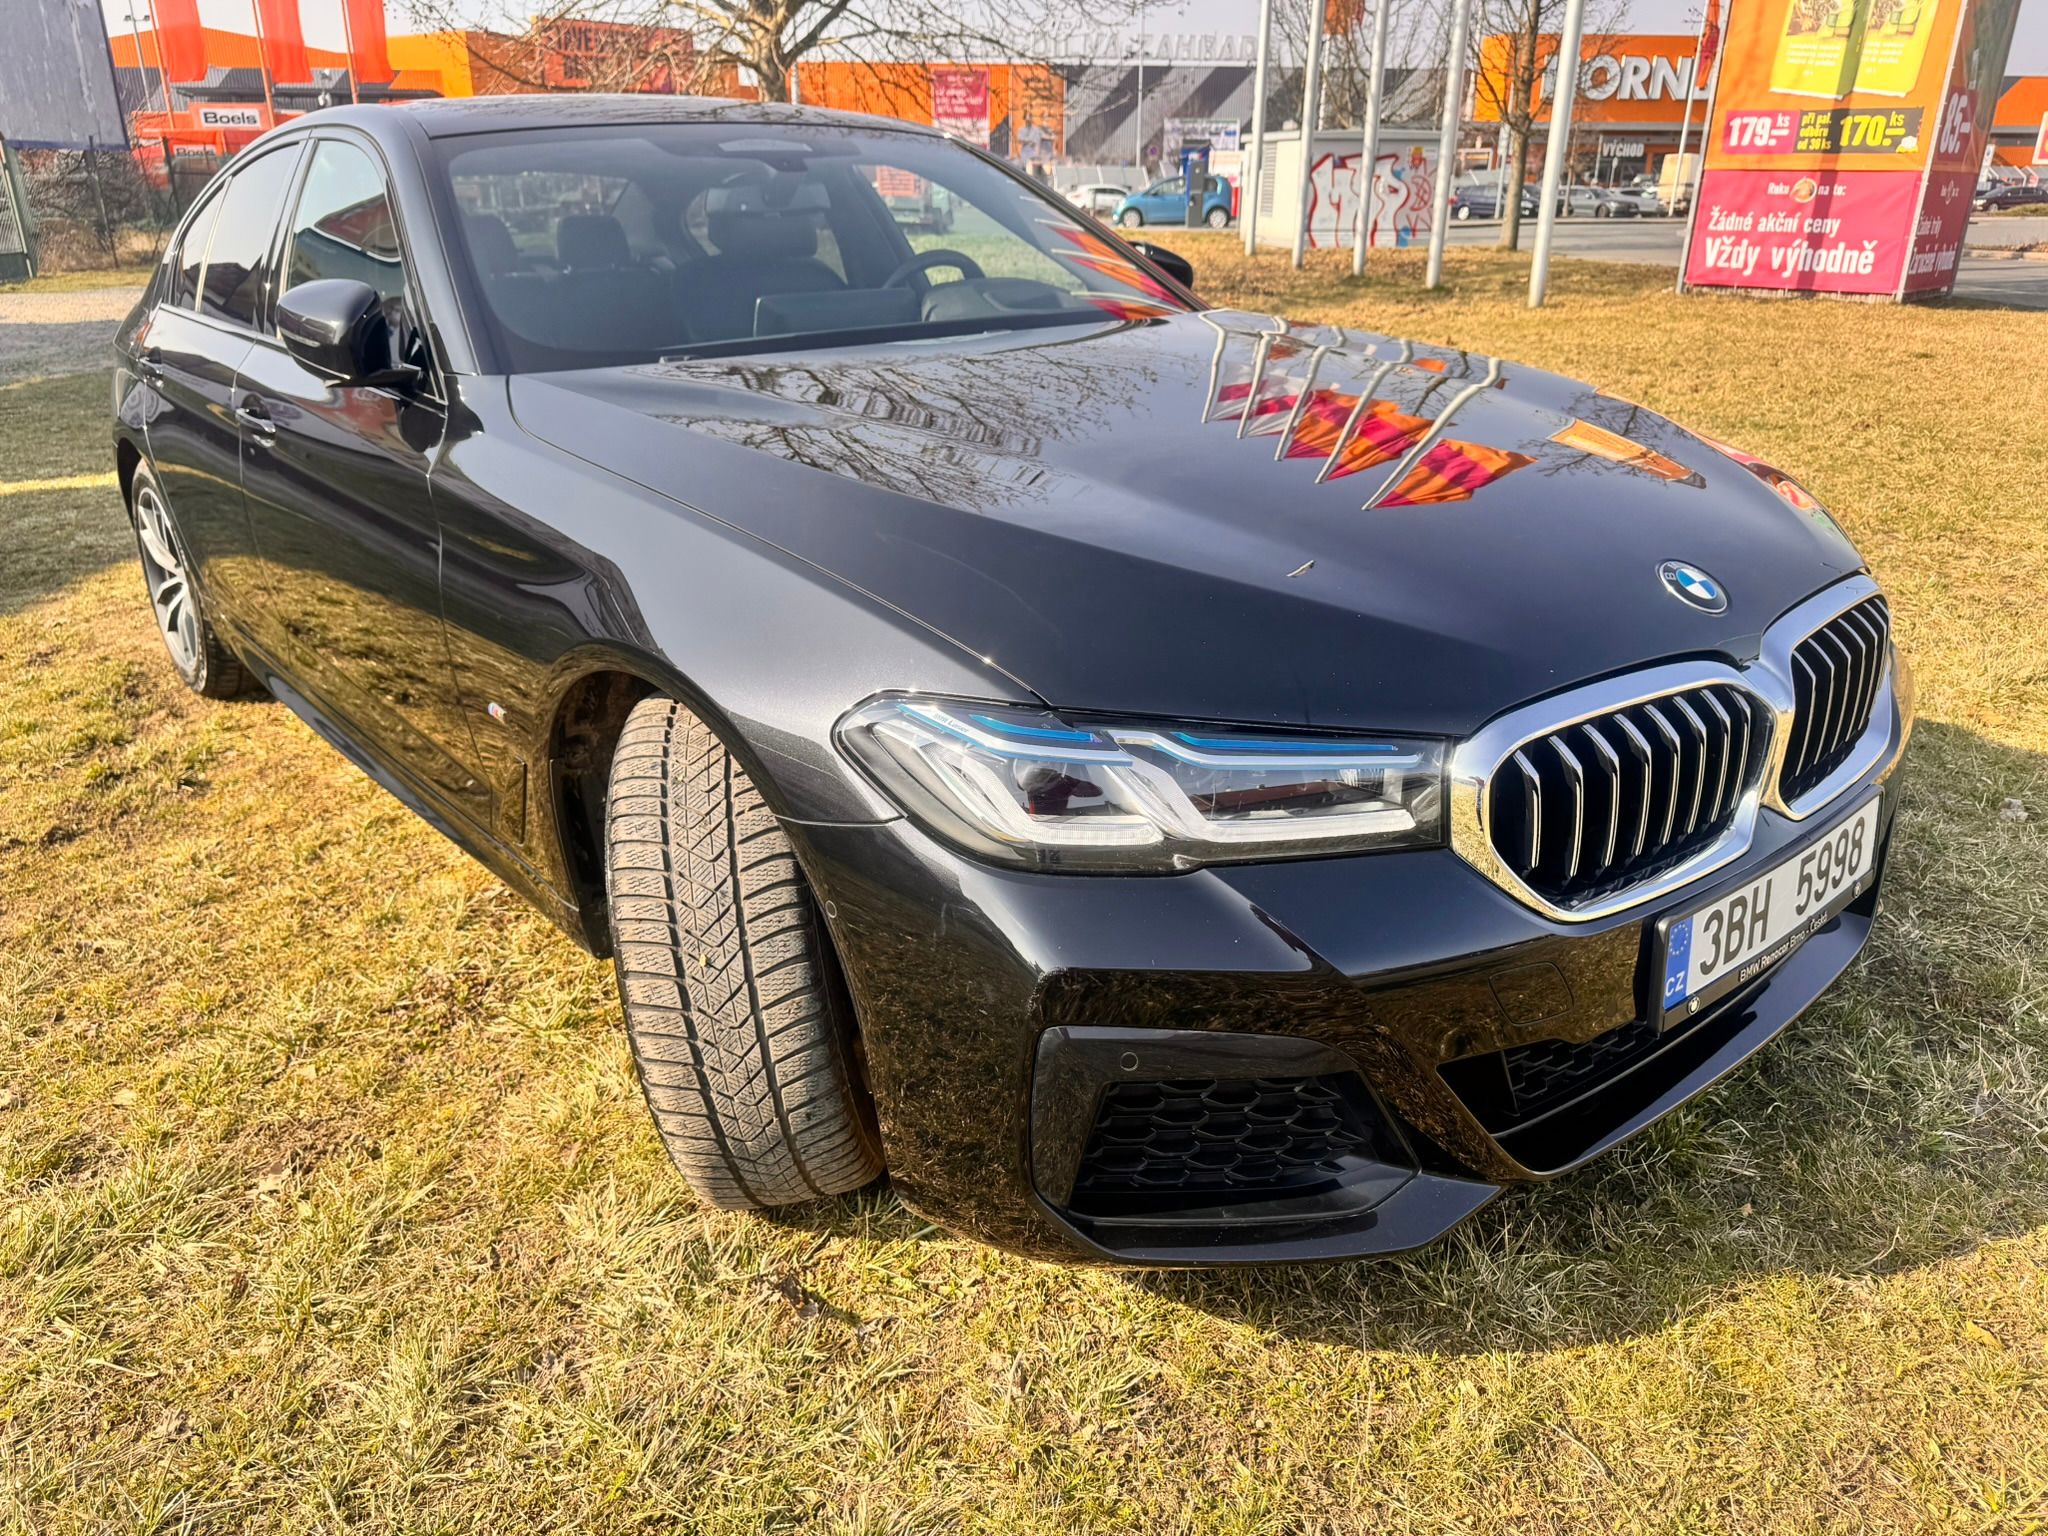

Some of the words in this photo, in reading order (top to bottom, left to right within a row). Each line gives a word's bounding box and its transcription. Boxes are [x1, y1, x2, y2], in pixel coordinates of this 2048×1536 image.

[1136, 34, 1258, 60] ZAHRAD
[203, 111, 257, 124] Boels
[1602, 139, 1644, 158] VÝCHOD
[1818, 184, 1829, 195] na
[1708, 205, 1754, 231] Žádné
[1757, 211, 1801, 233] akční
[1803, 218, 1841, 238] ceny
[1705, 235, 1761, 277] Vždy
[1771, 238, 1878, 279] výhodně
[1665, 971, 1684, 997] CZ
[1699, 879, 1773, 975] 3BH
[1796, 816, 1865, 916] 5998
[1740, 959, 1761, 982] BMW
